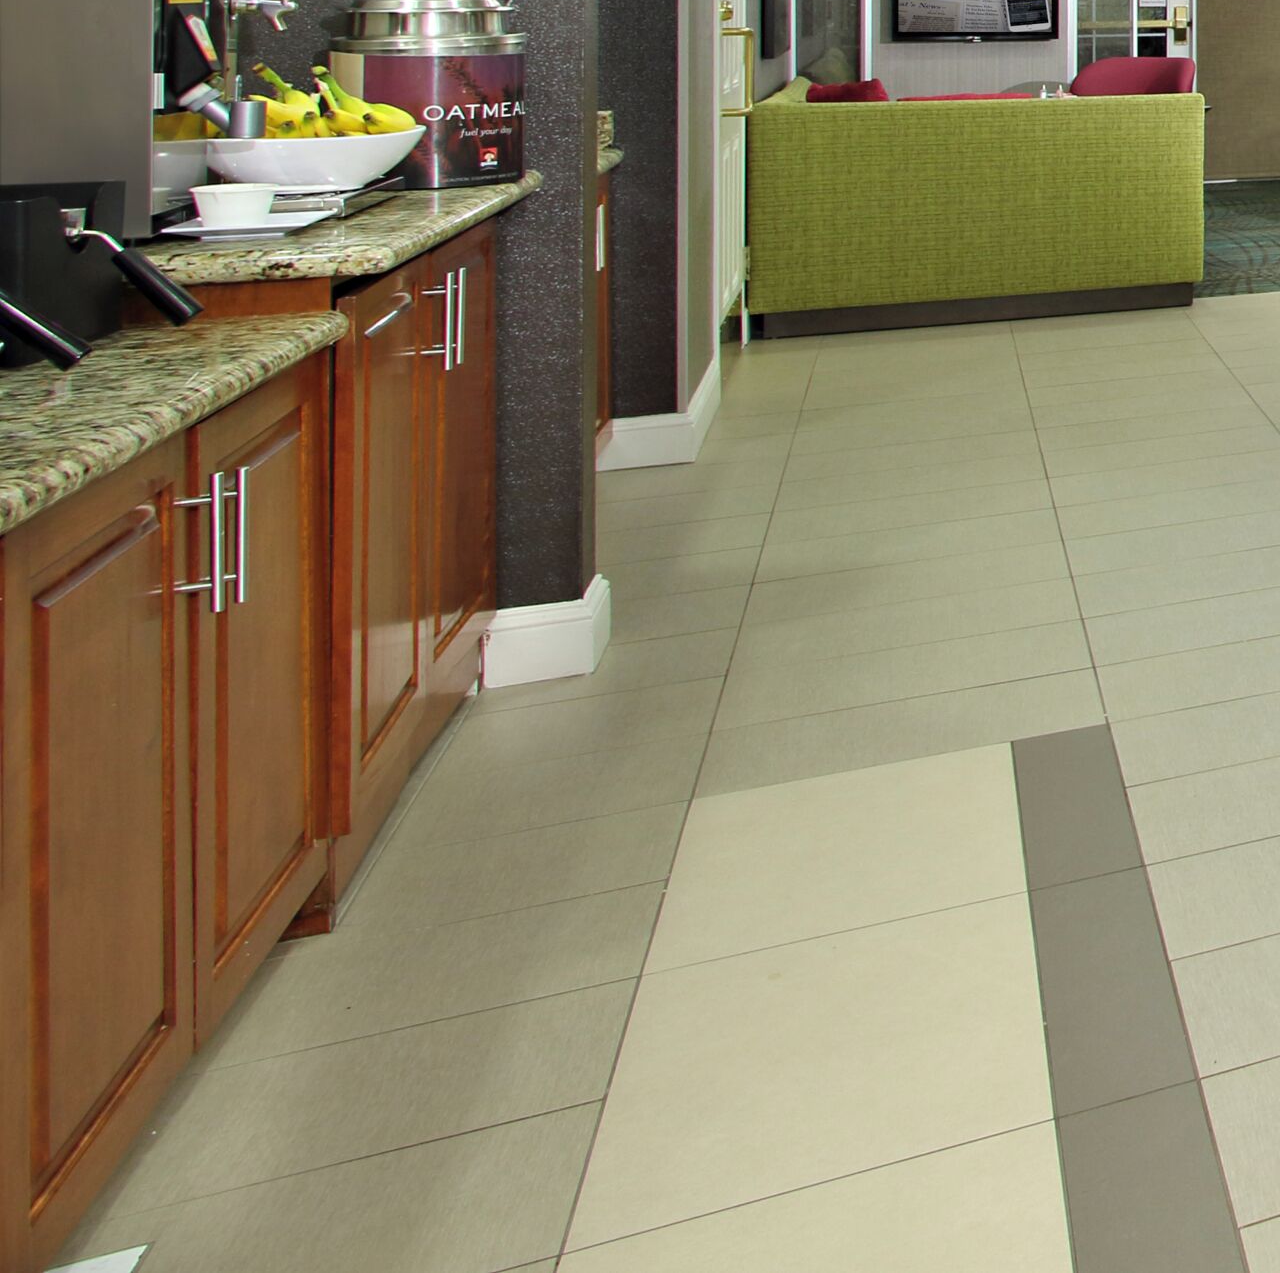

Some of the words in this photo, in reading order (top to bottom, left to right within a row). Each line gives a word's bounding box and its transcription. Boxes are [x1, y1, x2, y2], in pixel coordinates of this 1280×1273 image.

[423, 100, 526, 121] OATMEAL
[459, 127, 479, 139] fuel
[480, 128, 499, 138] your
